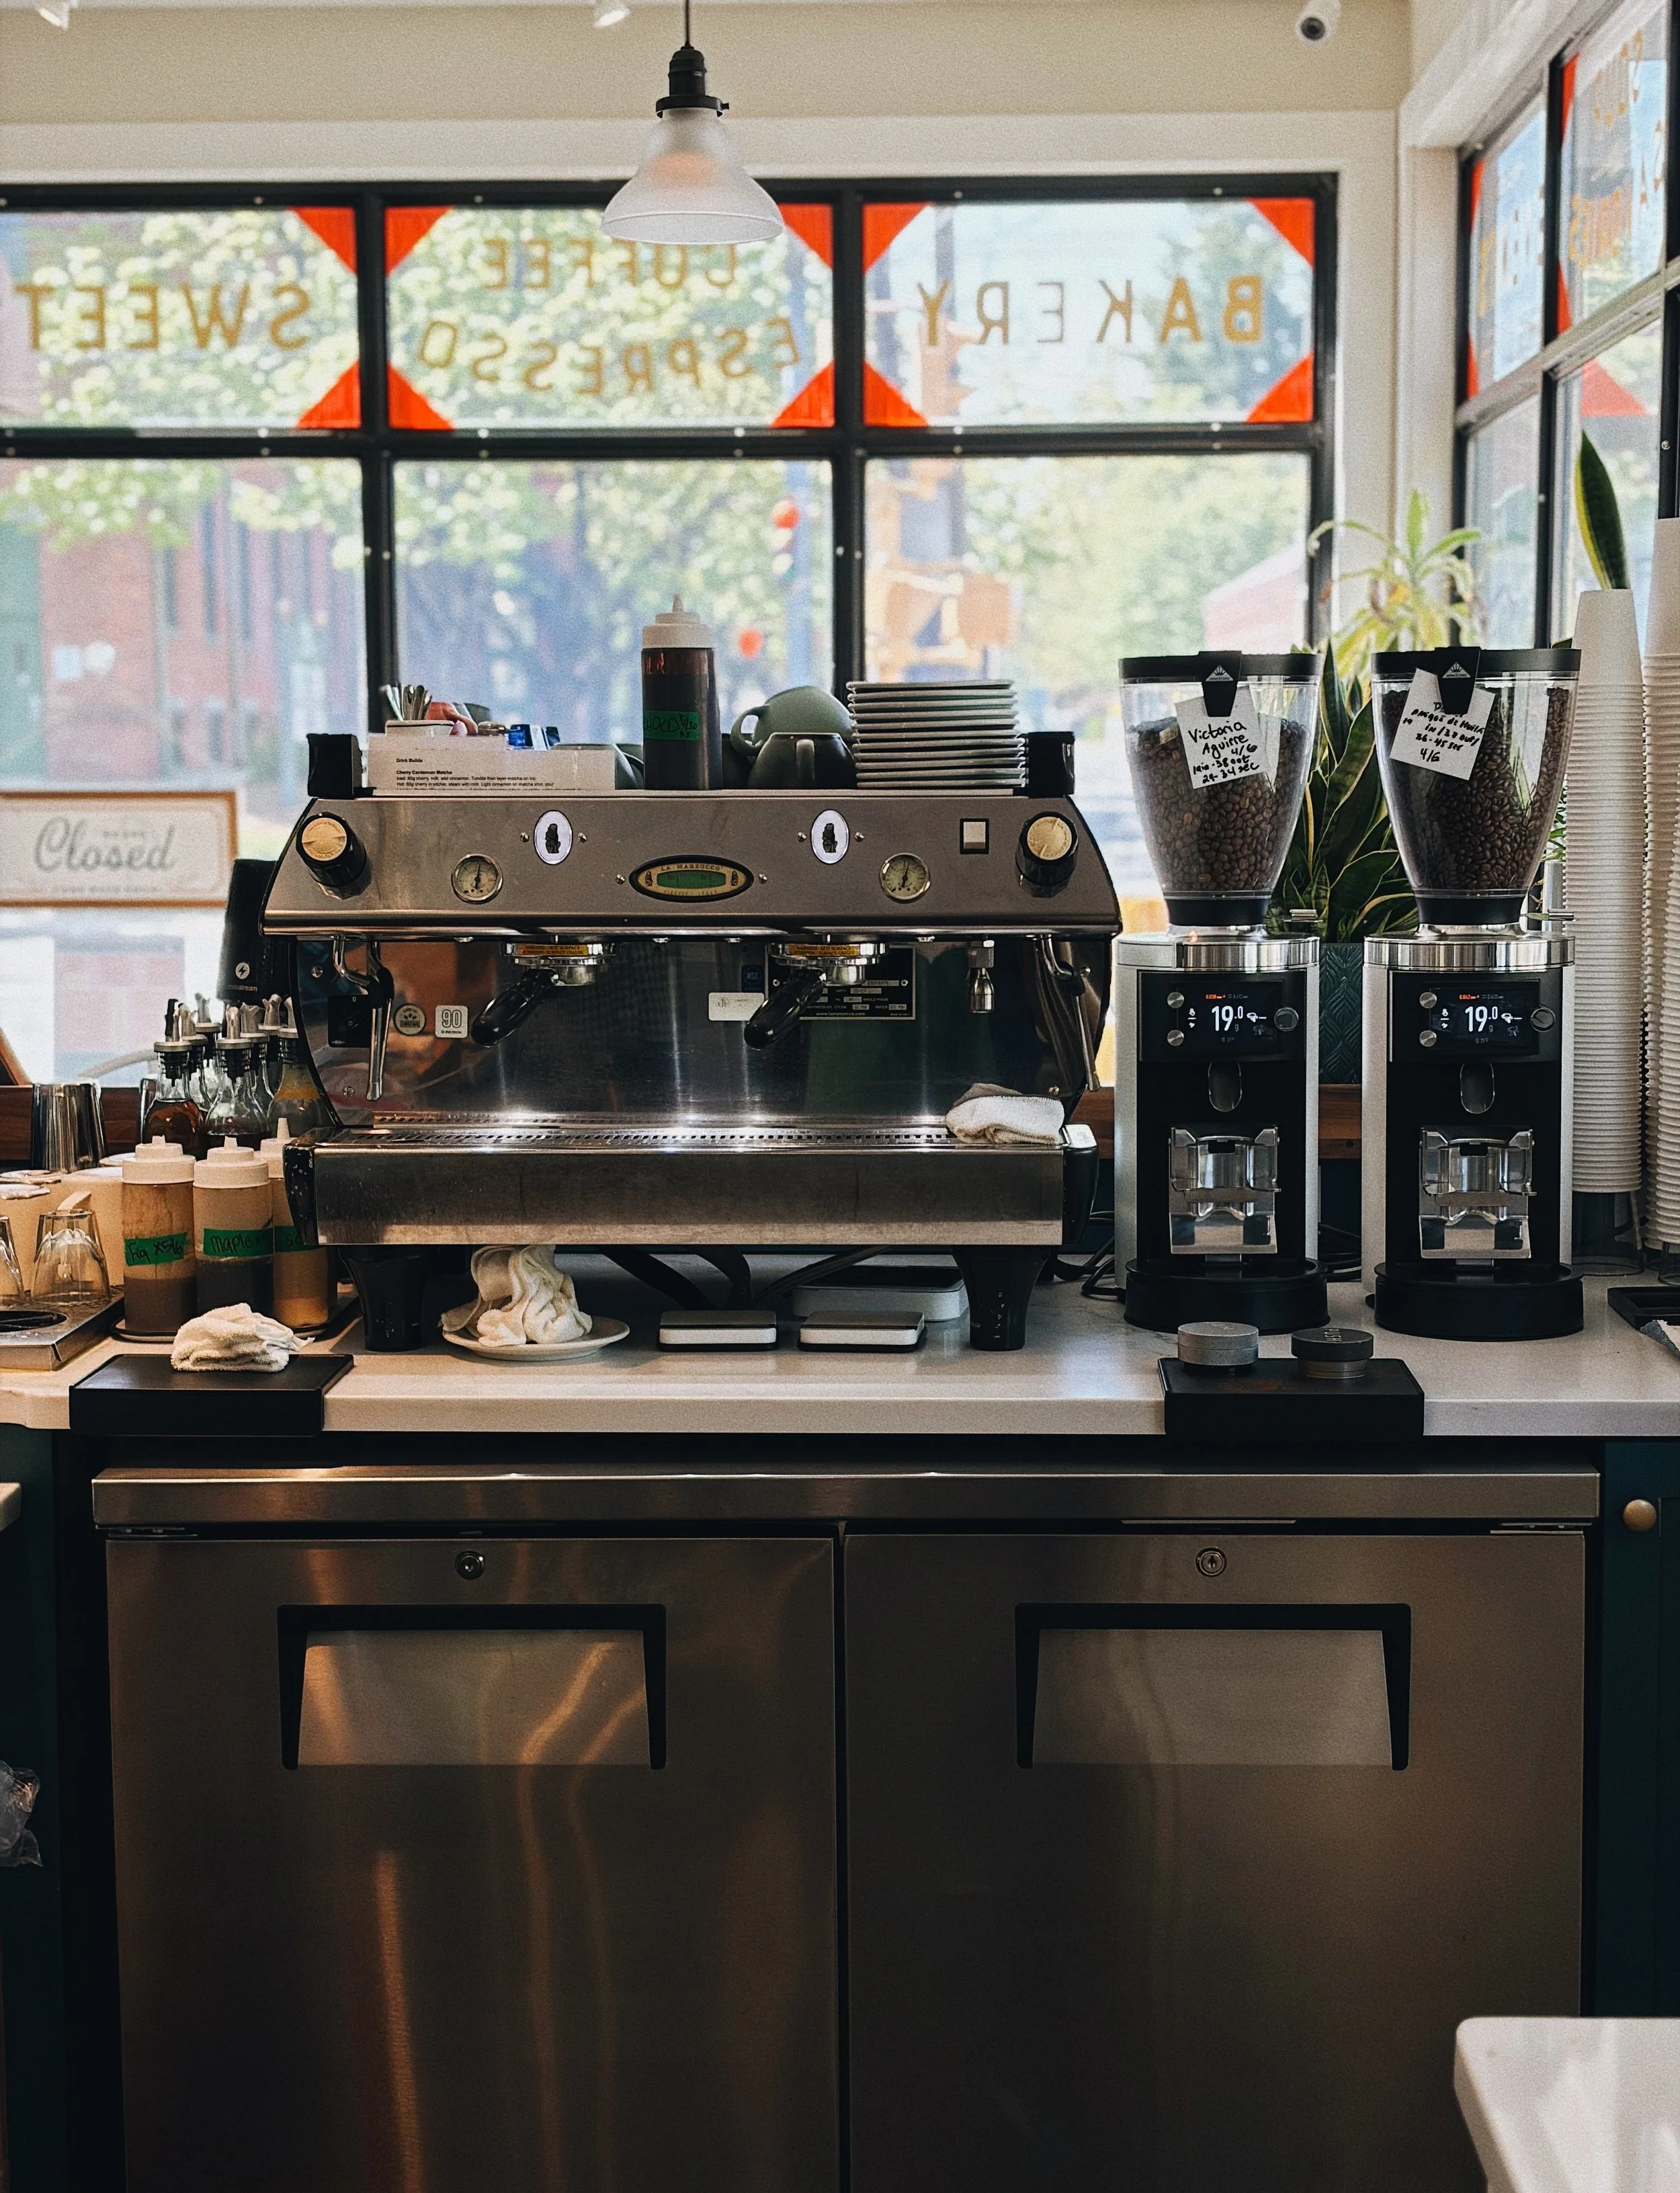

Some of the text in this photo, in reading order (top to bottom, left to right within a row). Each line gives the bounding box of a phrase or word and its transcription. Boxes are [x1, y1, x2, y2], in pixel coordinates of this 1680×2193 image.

[1188, 720, 1247, 743] Victoria
[1202, 735, 1249, 759] Aguirre
[1231, 743, 1258, 756] 4/6
[34, 815, 177, 872] Closed
[442, 1009, 462, 1028] 90
[128, 1242, 151, 1264] Fig
[210, 1233, 254, 1254] Maple
